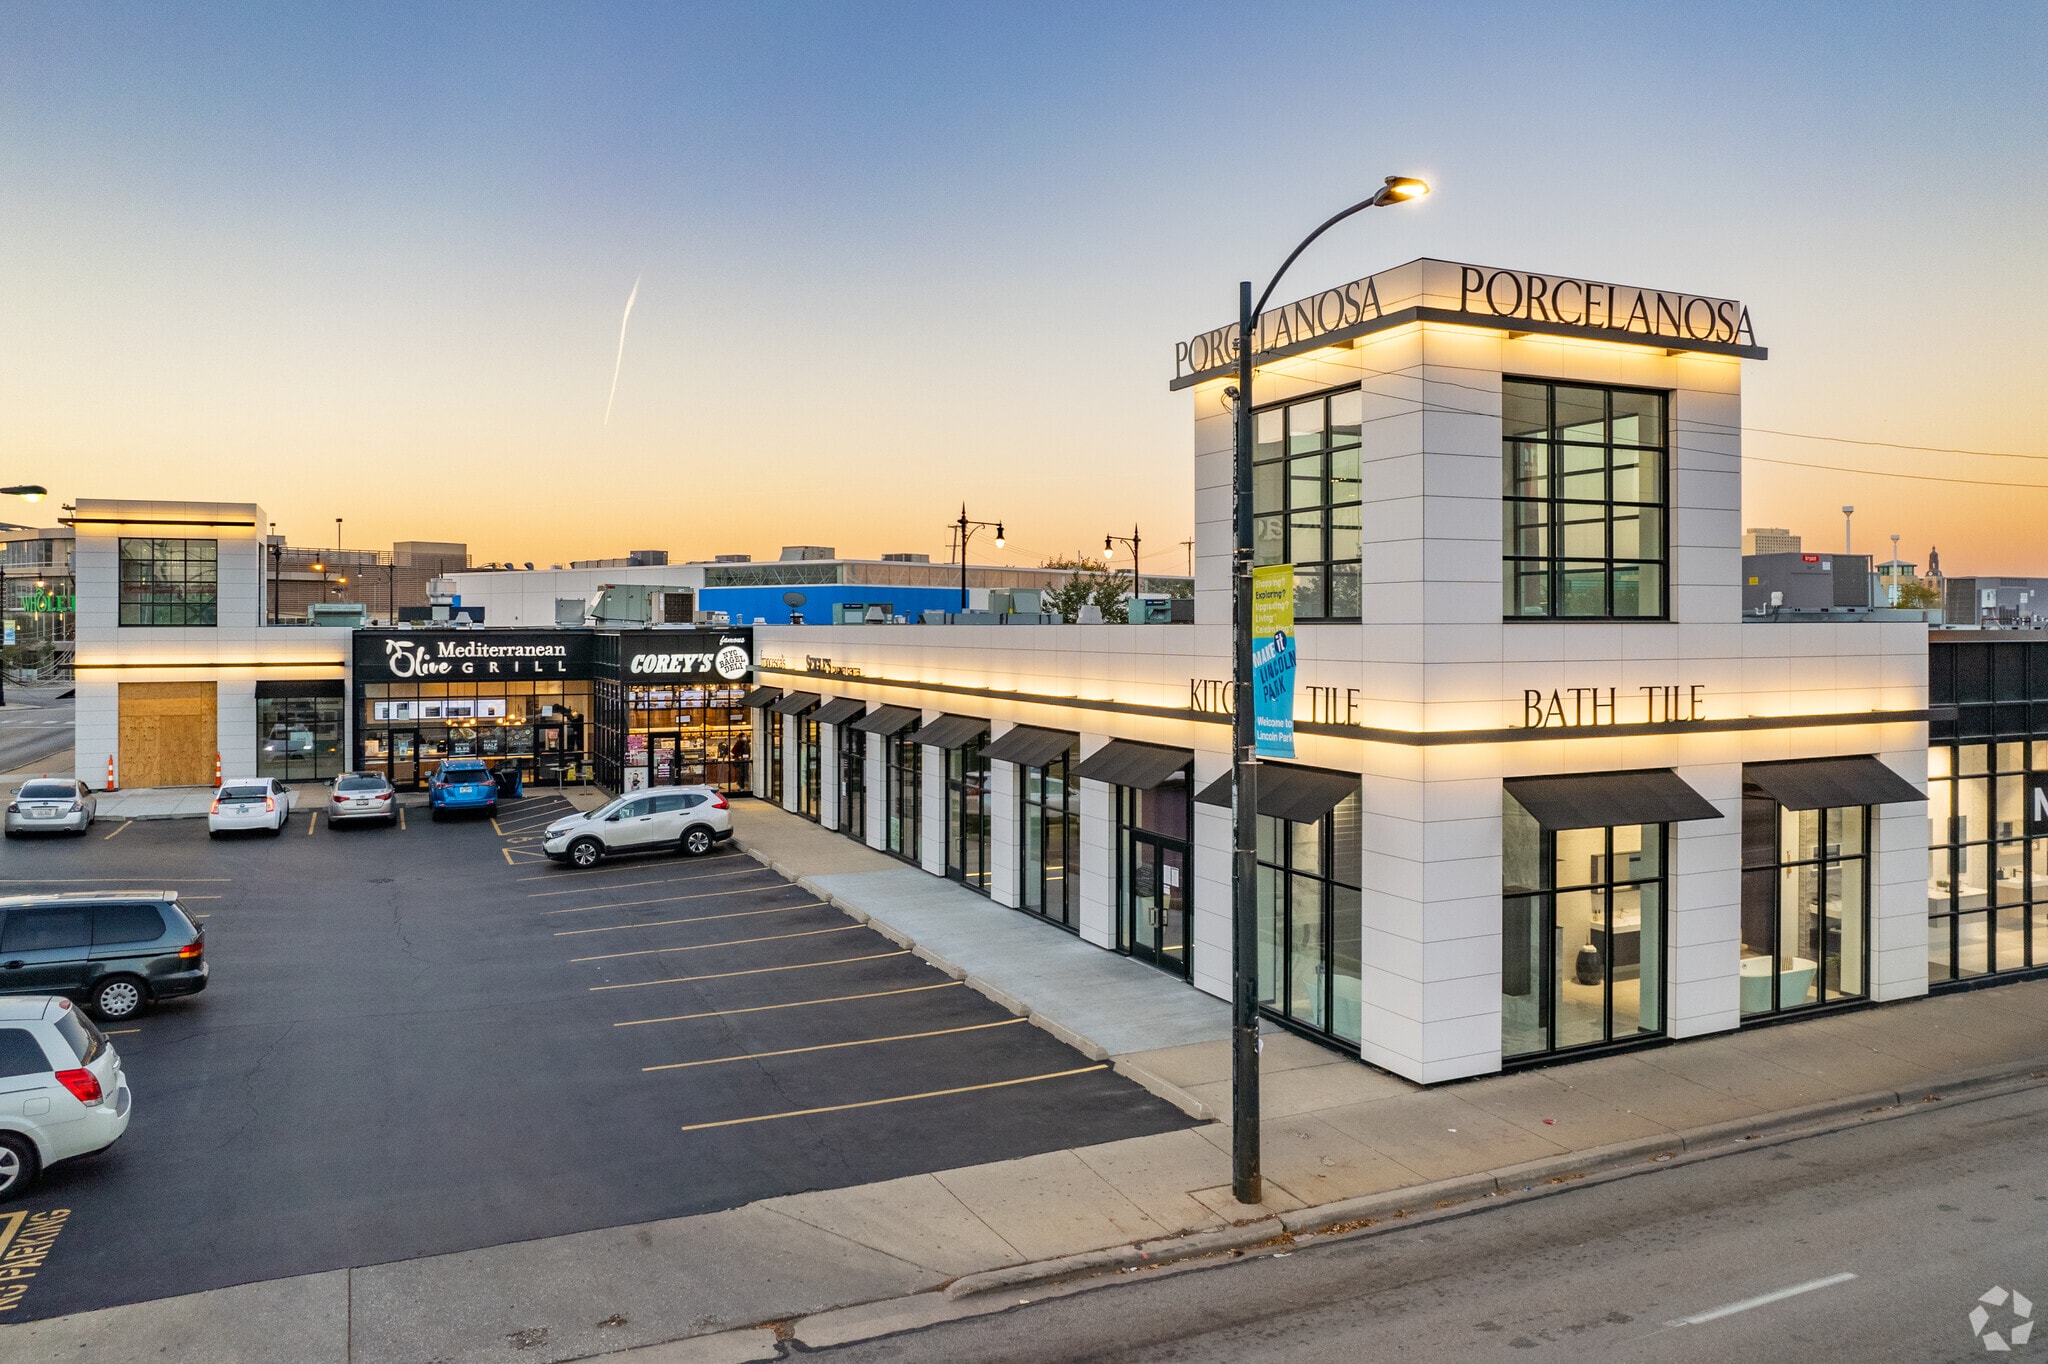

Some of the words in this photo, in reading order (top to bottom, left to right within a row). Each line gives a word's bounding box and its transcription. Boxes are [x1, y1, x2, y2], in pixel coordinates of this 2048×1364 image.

[1460, 266, 1757, 347] PORCELANOSA
[1175, 276, 1384, 379] PORCLANOSA
[1255, 577, 1286, 589] Shopping?
[22, 590, 67, 611] WHOLE
[1255, 589, 1287, 601] Exploring?
[1255, 601, 1290, 613] Upgrading?
[437, 641, 567, 658] Mediterranean
[719, 635, 745, 646] famous
[386, 639, 452, 678] Olive
[722, 650, 738, 659] NYC
[1252, 642, 1276, 668] MAKE
[1275, 633, 1286, 653] it
[461, 660, 567, 674] GRILL
[630, 653, 715, 674] COREY'S
[719, 655, 746, 669] BAGEL
[724, 663, 744, 674] DELI
[1259, 649, 1297, 685] LINCOLN
[1263, 675, 1287, 703] PARK
[1305, 685, 1361, 727] TILE
[1524, 687, 1616, 729] BATH
[1639, 684, 1706, 723] TILE
[1257, 716, 1284, 728] Welcome
[1285, 718, 1293, 728] to
[1256, 730, 1279, 741] Lincoln
[1279, 732, 1294, 743] Park
[0, 1208, 72, 1281] PARKING
